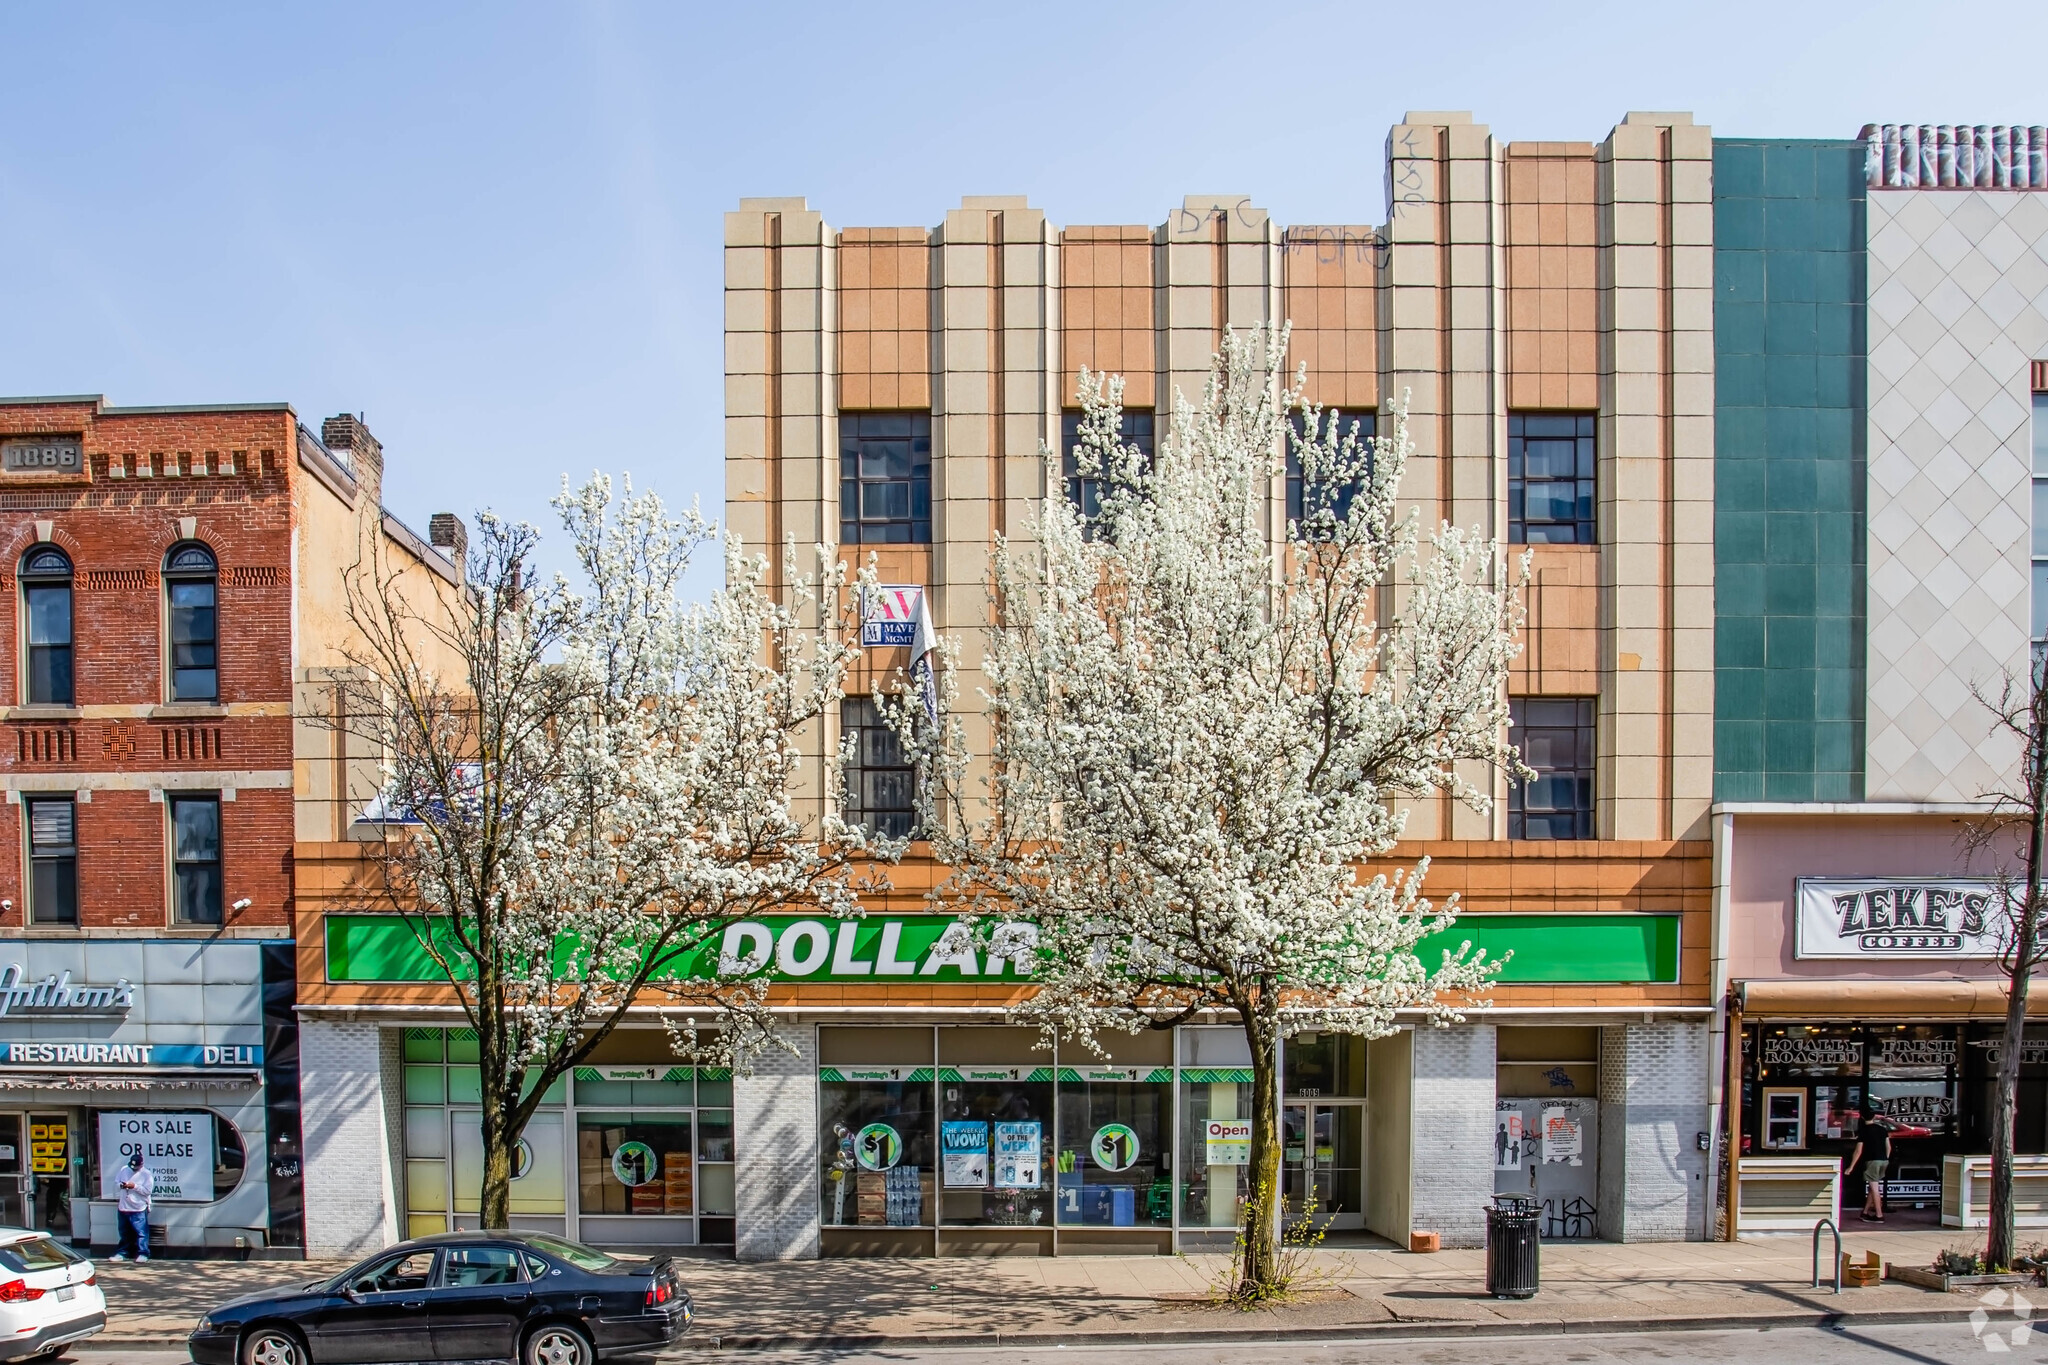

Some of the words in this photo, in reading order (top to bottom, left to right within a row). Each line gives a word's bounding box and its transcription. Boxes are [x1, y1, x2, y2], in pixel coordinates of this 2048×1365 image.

[9, 447, 76, 467] 1886
[1832, 886, 1991, 938] ZEKE'S
[716, 920, 1041, 976] DOLLAR
[1865, 936, 1955, 947] COFFEE
[1766, 1039, 1858, 1052] LOCALLY
[1882, 1040, 1957, 1052] FRESH
[9, 1043, 153, 1064] RESTAURANT
[204, 1046, 253, 1065] DELI
[1765, 1052, 1859, 1064] ROASTED
[1882, 1053, 1956, 1064] BAKED
[1300, 1089, 1319, 1097] 6009
[1884, 1097, 1954, 1117] ZEKE'S
[120, 1120, 150, 1134] FOR
[155, 1120, 192, 1134] SALE
[1000, 1125, 1037, 1135] CHILLER
[1209, 1123, 1249, 1139] Open
[946, 1133, 986, 1148] WOW!
[1001, 1141, 1035, 1152] WEEK!
[120, 1143, 142, 1156] OR
[149, 1143, 193, 1157] LEASE
[864, 1133, 891, 1169] $1
[1101, 1133, 1128, 1170] $1
[1904, 1185, 1921, 1193] THE
[1059, 1186, 1079, 1211] $1
